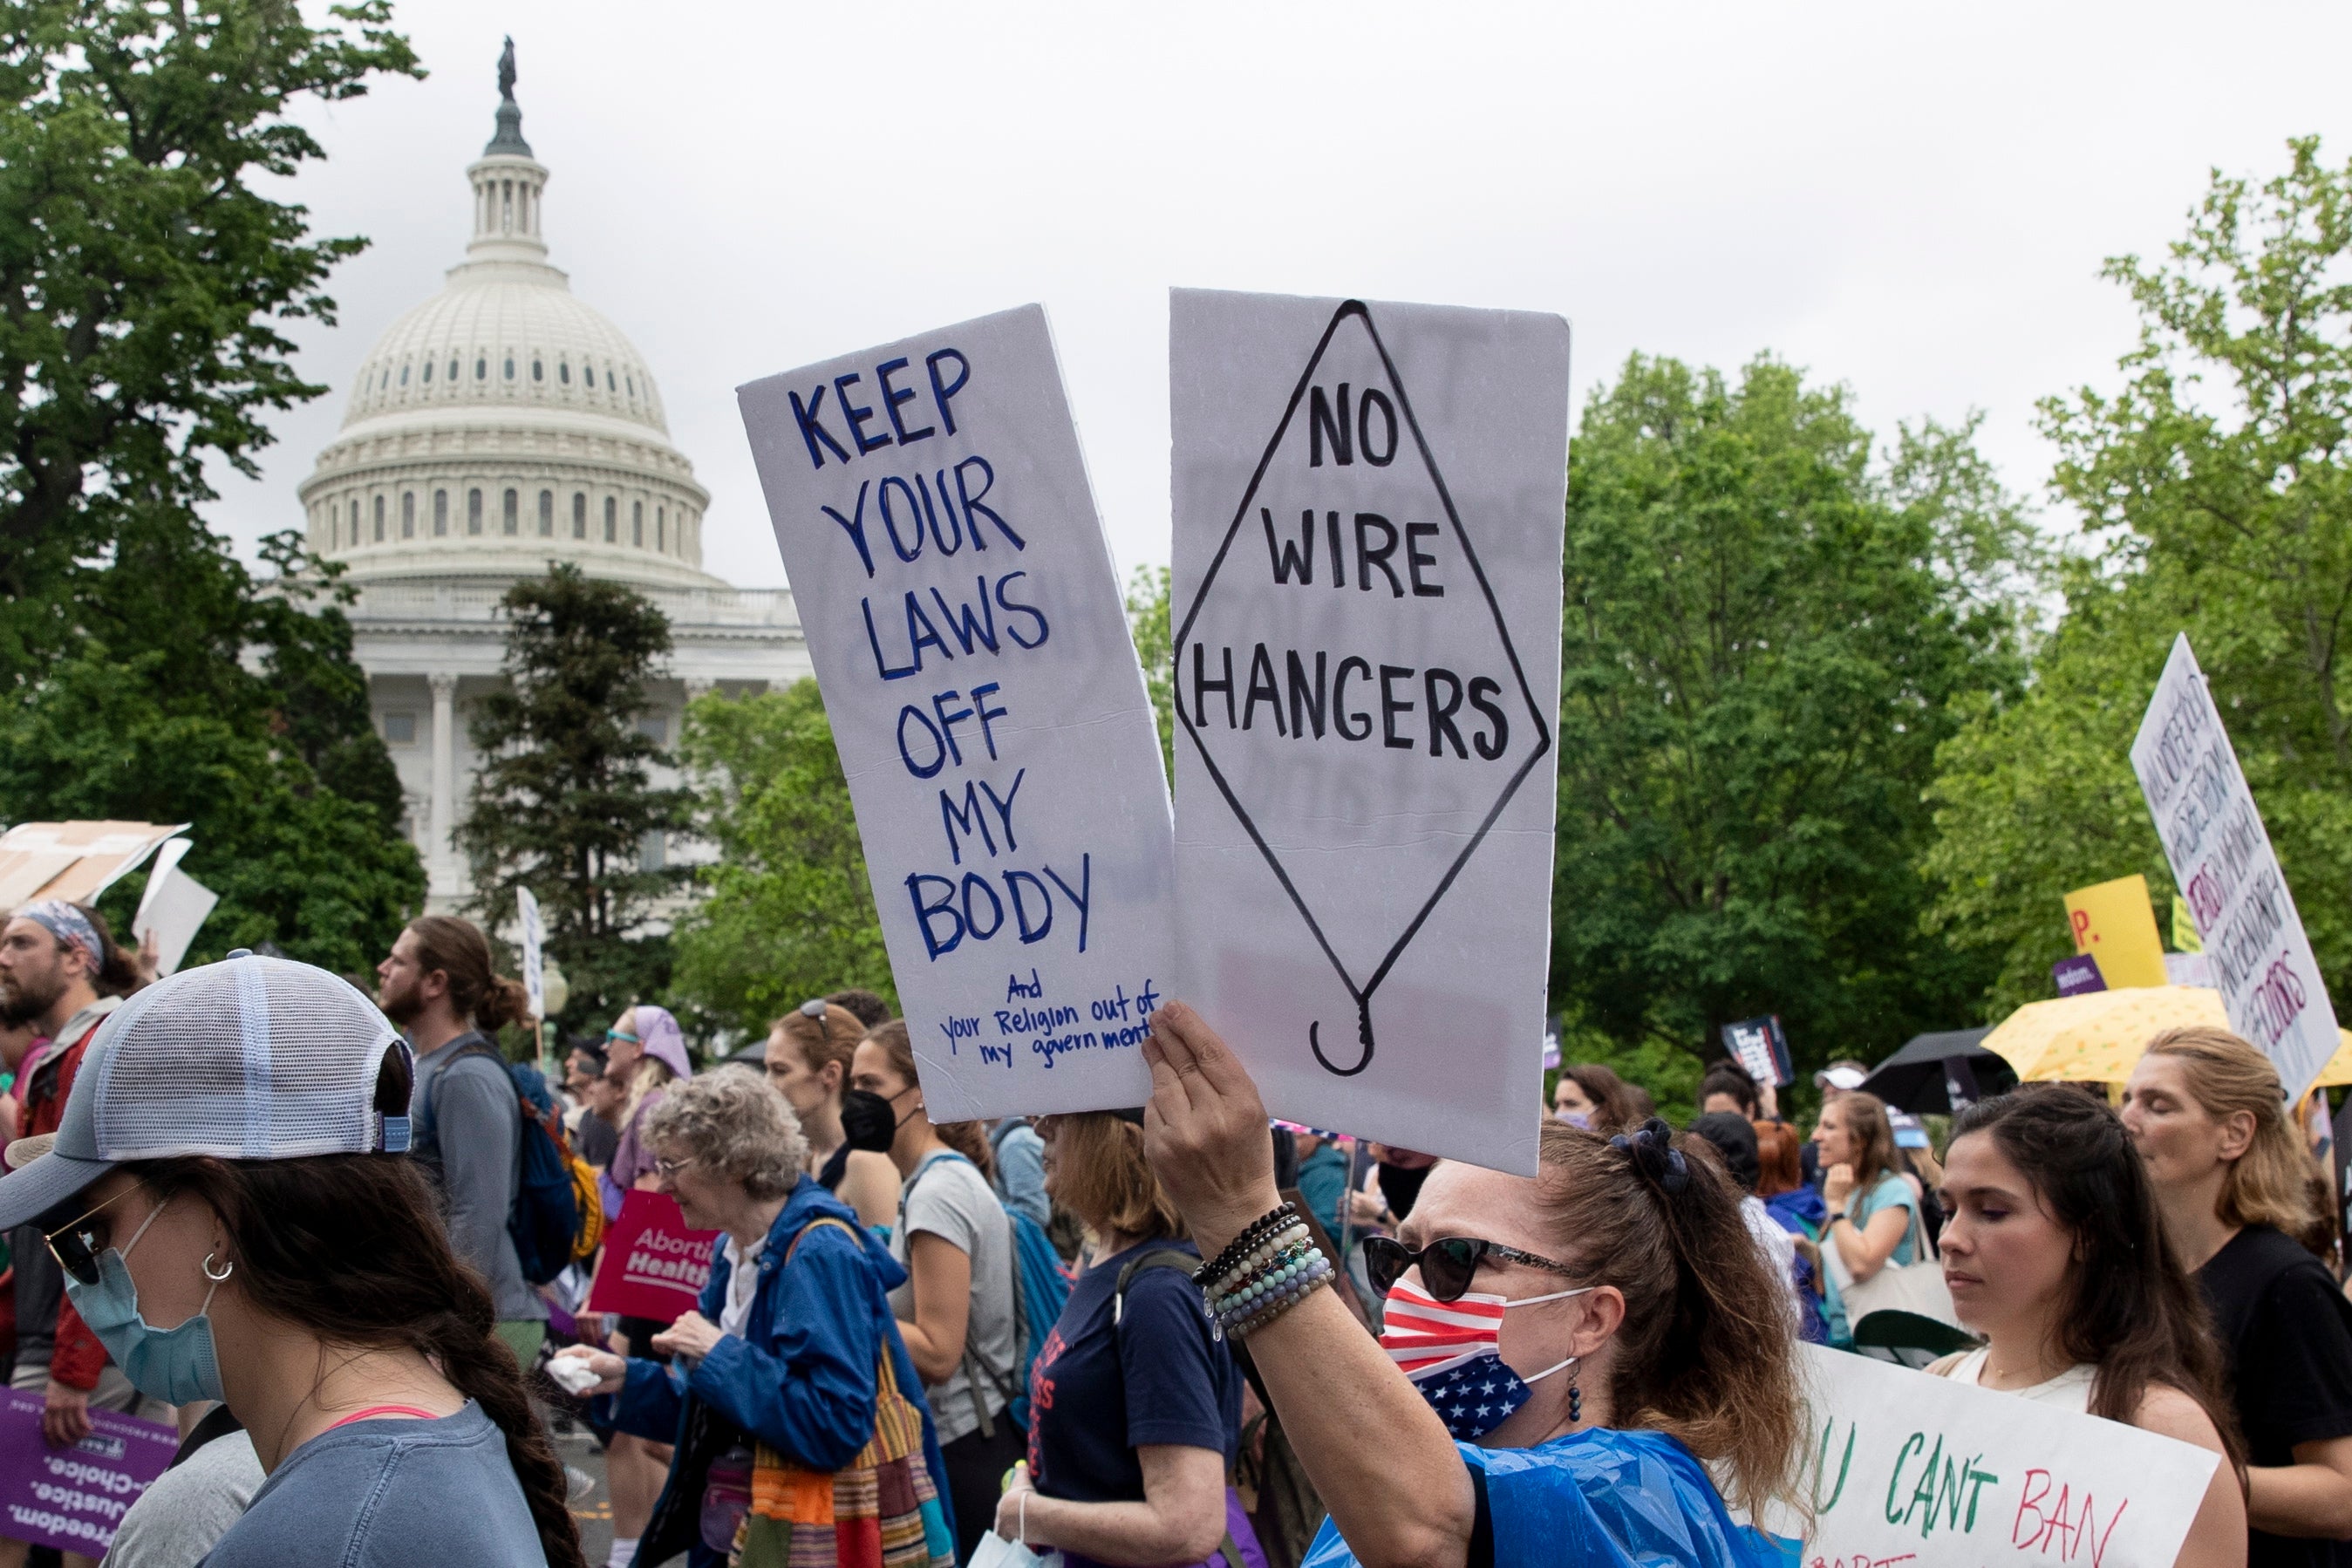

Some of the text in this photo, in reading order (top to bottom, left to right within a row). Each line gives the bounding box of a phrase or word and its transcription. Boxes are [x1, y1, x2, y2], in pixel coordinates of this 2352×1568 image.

[787, 348, 971, 470] KEEP
[1309, 382, 1399, 467] NO
[821, 455, 1026, 578] YOUR
[1261, 507, 1444, 598] WIRE
[861, 571, 1049, 680] LAWS
[896, 682, 1008, 779] OFF
[1193, 642, 1509, 761] HANGERS
[939, 767, 1026, 865] MY
[904, 852, 1090, 962] BODY
[2070, 910, 2101, 948] P.
[939, 978, 1160, 1055] your Religion out of
[1006, 967, 1043, 1004] And
[978, 1042, 1012, 1068] my
[30, 1481, 127, 1520] Justice.
[2012, 1468, 2128, 1568] BAN
